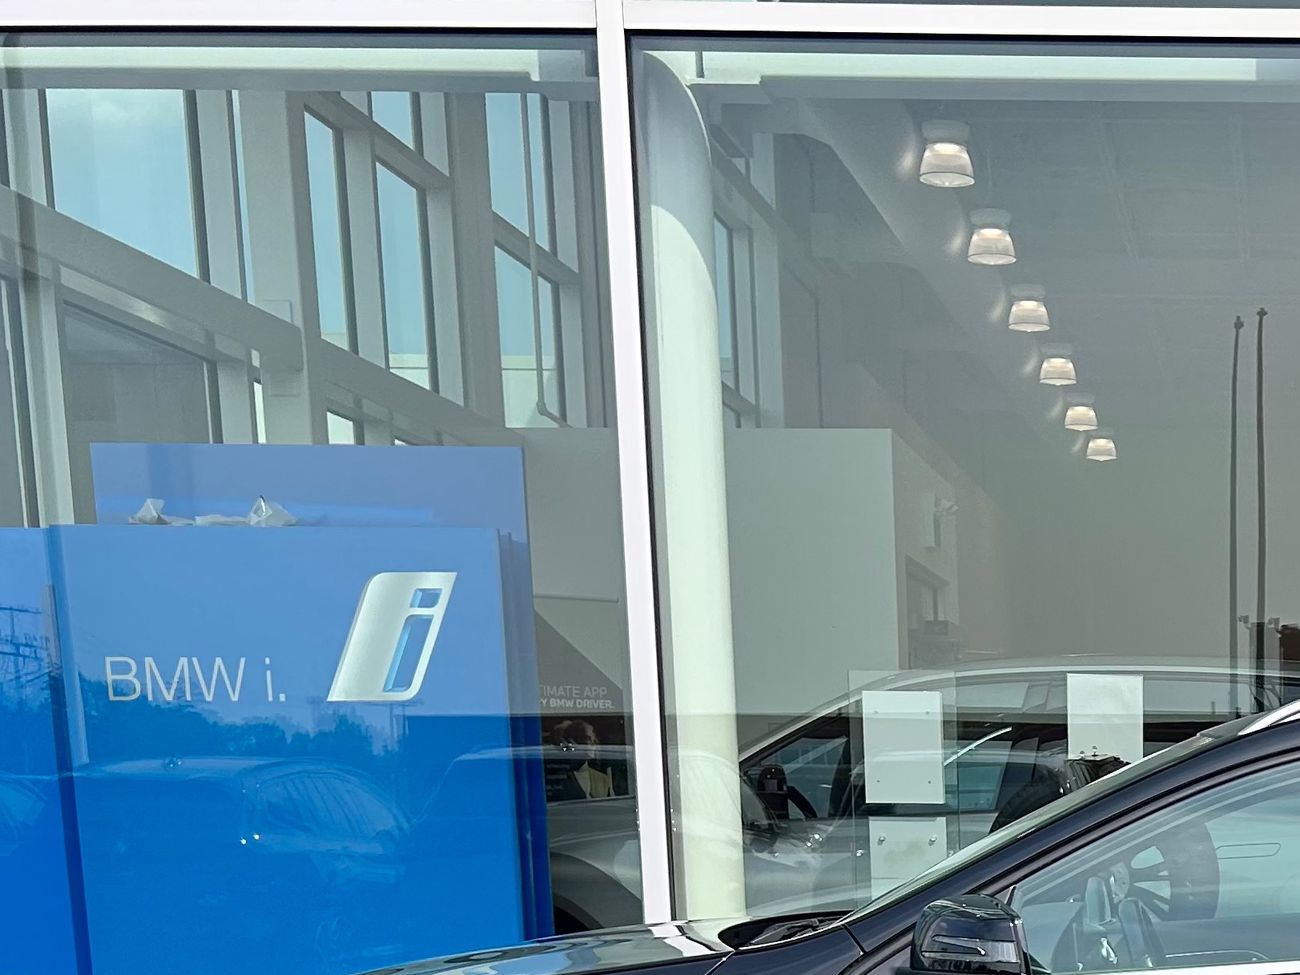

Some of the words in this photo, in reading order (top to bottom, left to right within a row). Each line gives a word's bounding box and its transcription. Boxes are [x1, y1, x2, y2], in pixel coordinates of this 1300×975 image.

[105, 656, 246, 701] BMW
[264, 656, 286, 701] i.
[582, 686, 607, 698] APP
[549, 698, 574, 708] BMW
[576, 698, 615, 709] DRIVER.
